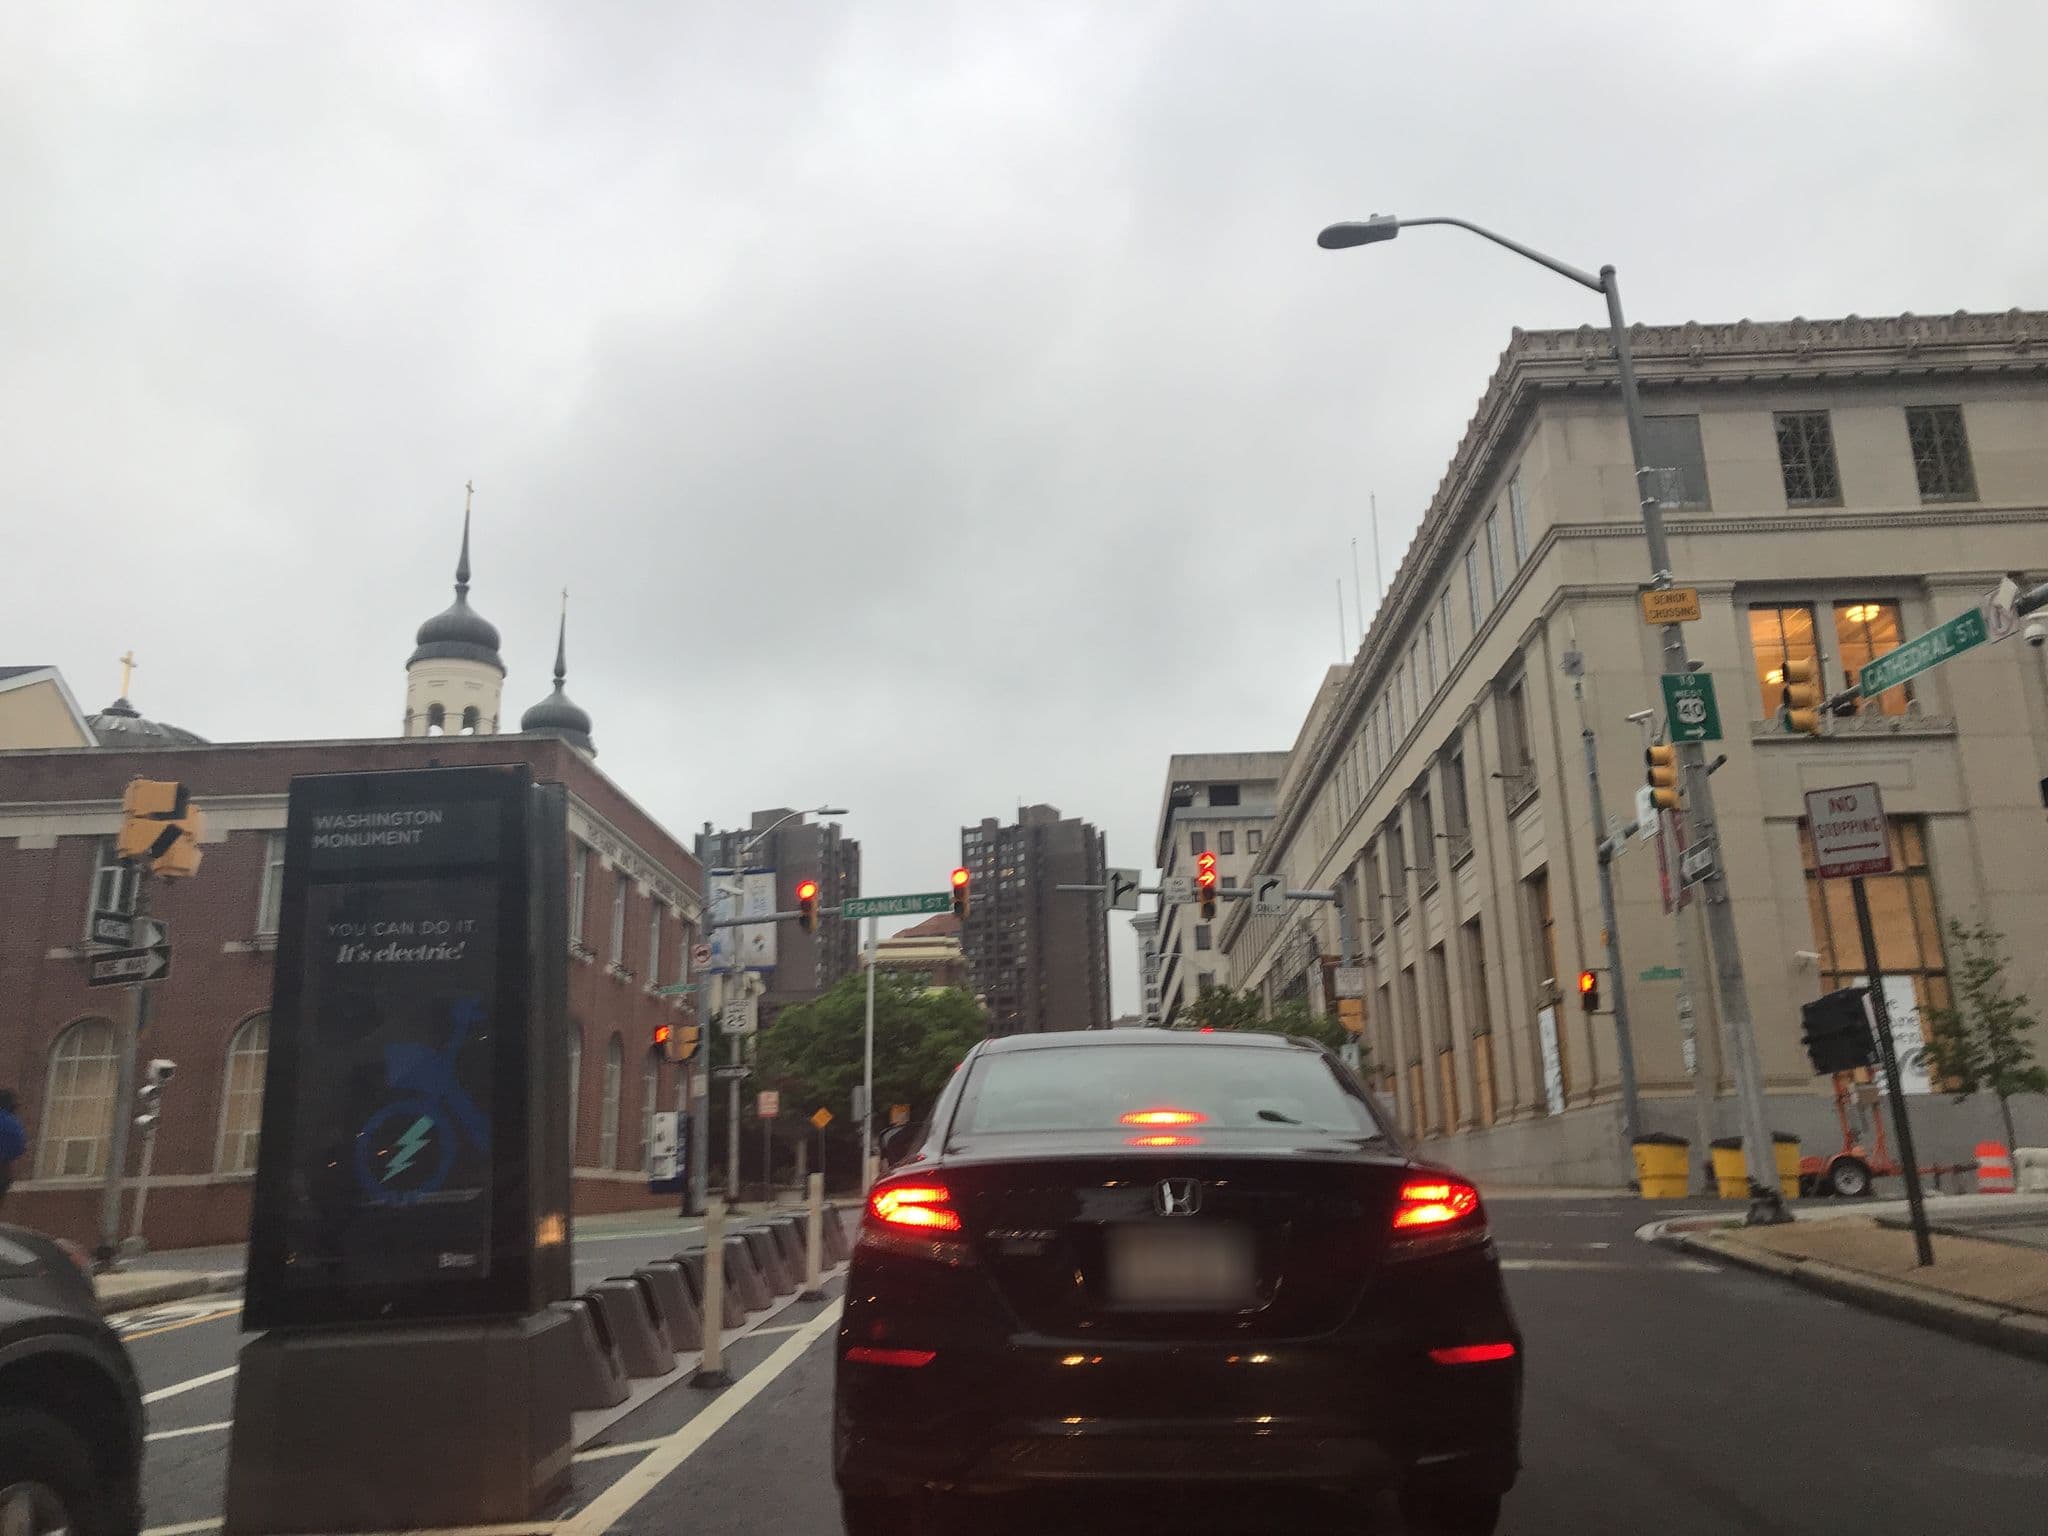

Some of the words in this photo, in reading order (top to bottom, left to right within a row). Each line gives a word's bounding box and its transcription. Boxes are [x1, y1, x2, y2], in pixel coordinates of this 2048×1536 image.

[1654, 593, 1688, 605] SENIOR
[1651, 608, 1697, 619] CROSSING
[1866, 631, 1956, 690] CATHEDRAL
[1674, 689, 1704, 699] WEST
[1681, 704, 1704, 718] 40
[1829, 796, 1858, 812] NO
[313, 811, 443, 829] WASHINGTON
[1816, 818, 1881, 838] STOPPING
[312, 830, 422, 848] MONUMENT
[848, 899, 922, 914] FRANKLIN
[328, 923, 366, 936] YOU
[373, 922, 414, 936] CAN
[421, 920, 450, 934] DO
[336, 943, 371, 963] It's
[373, 941, 466, 961] electric!
[727, 1014, 747, 1027] 25
